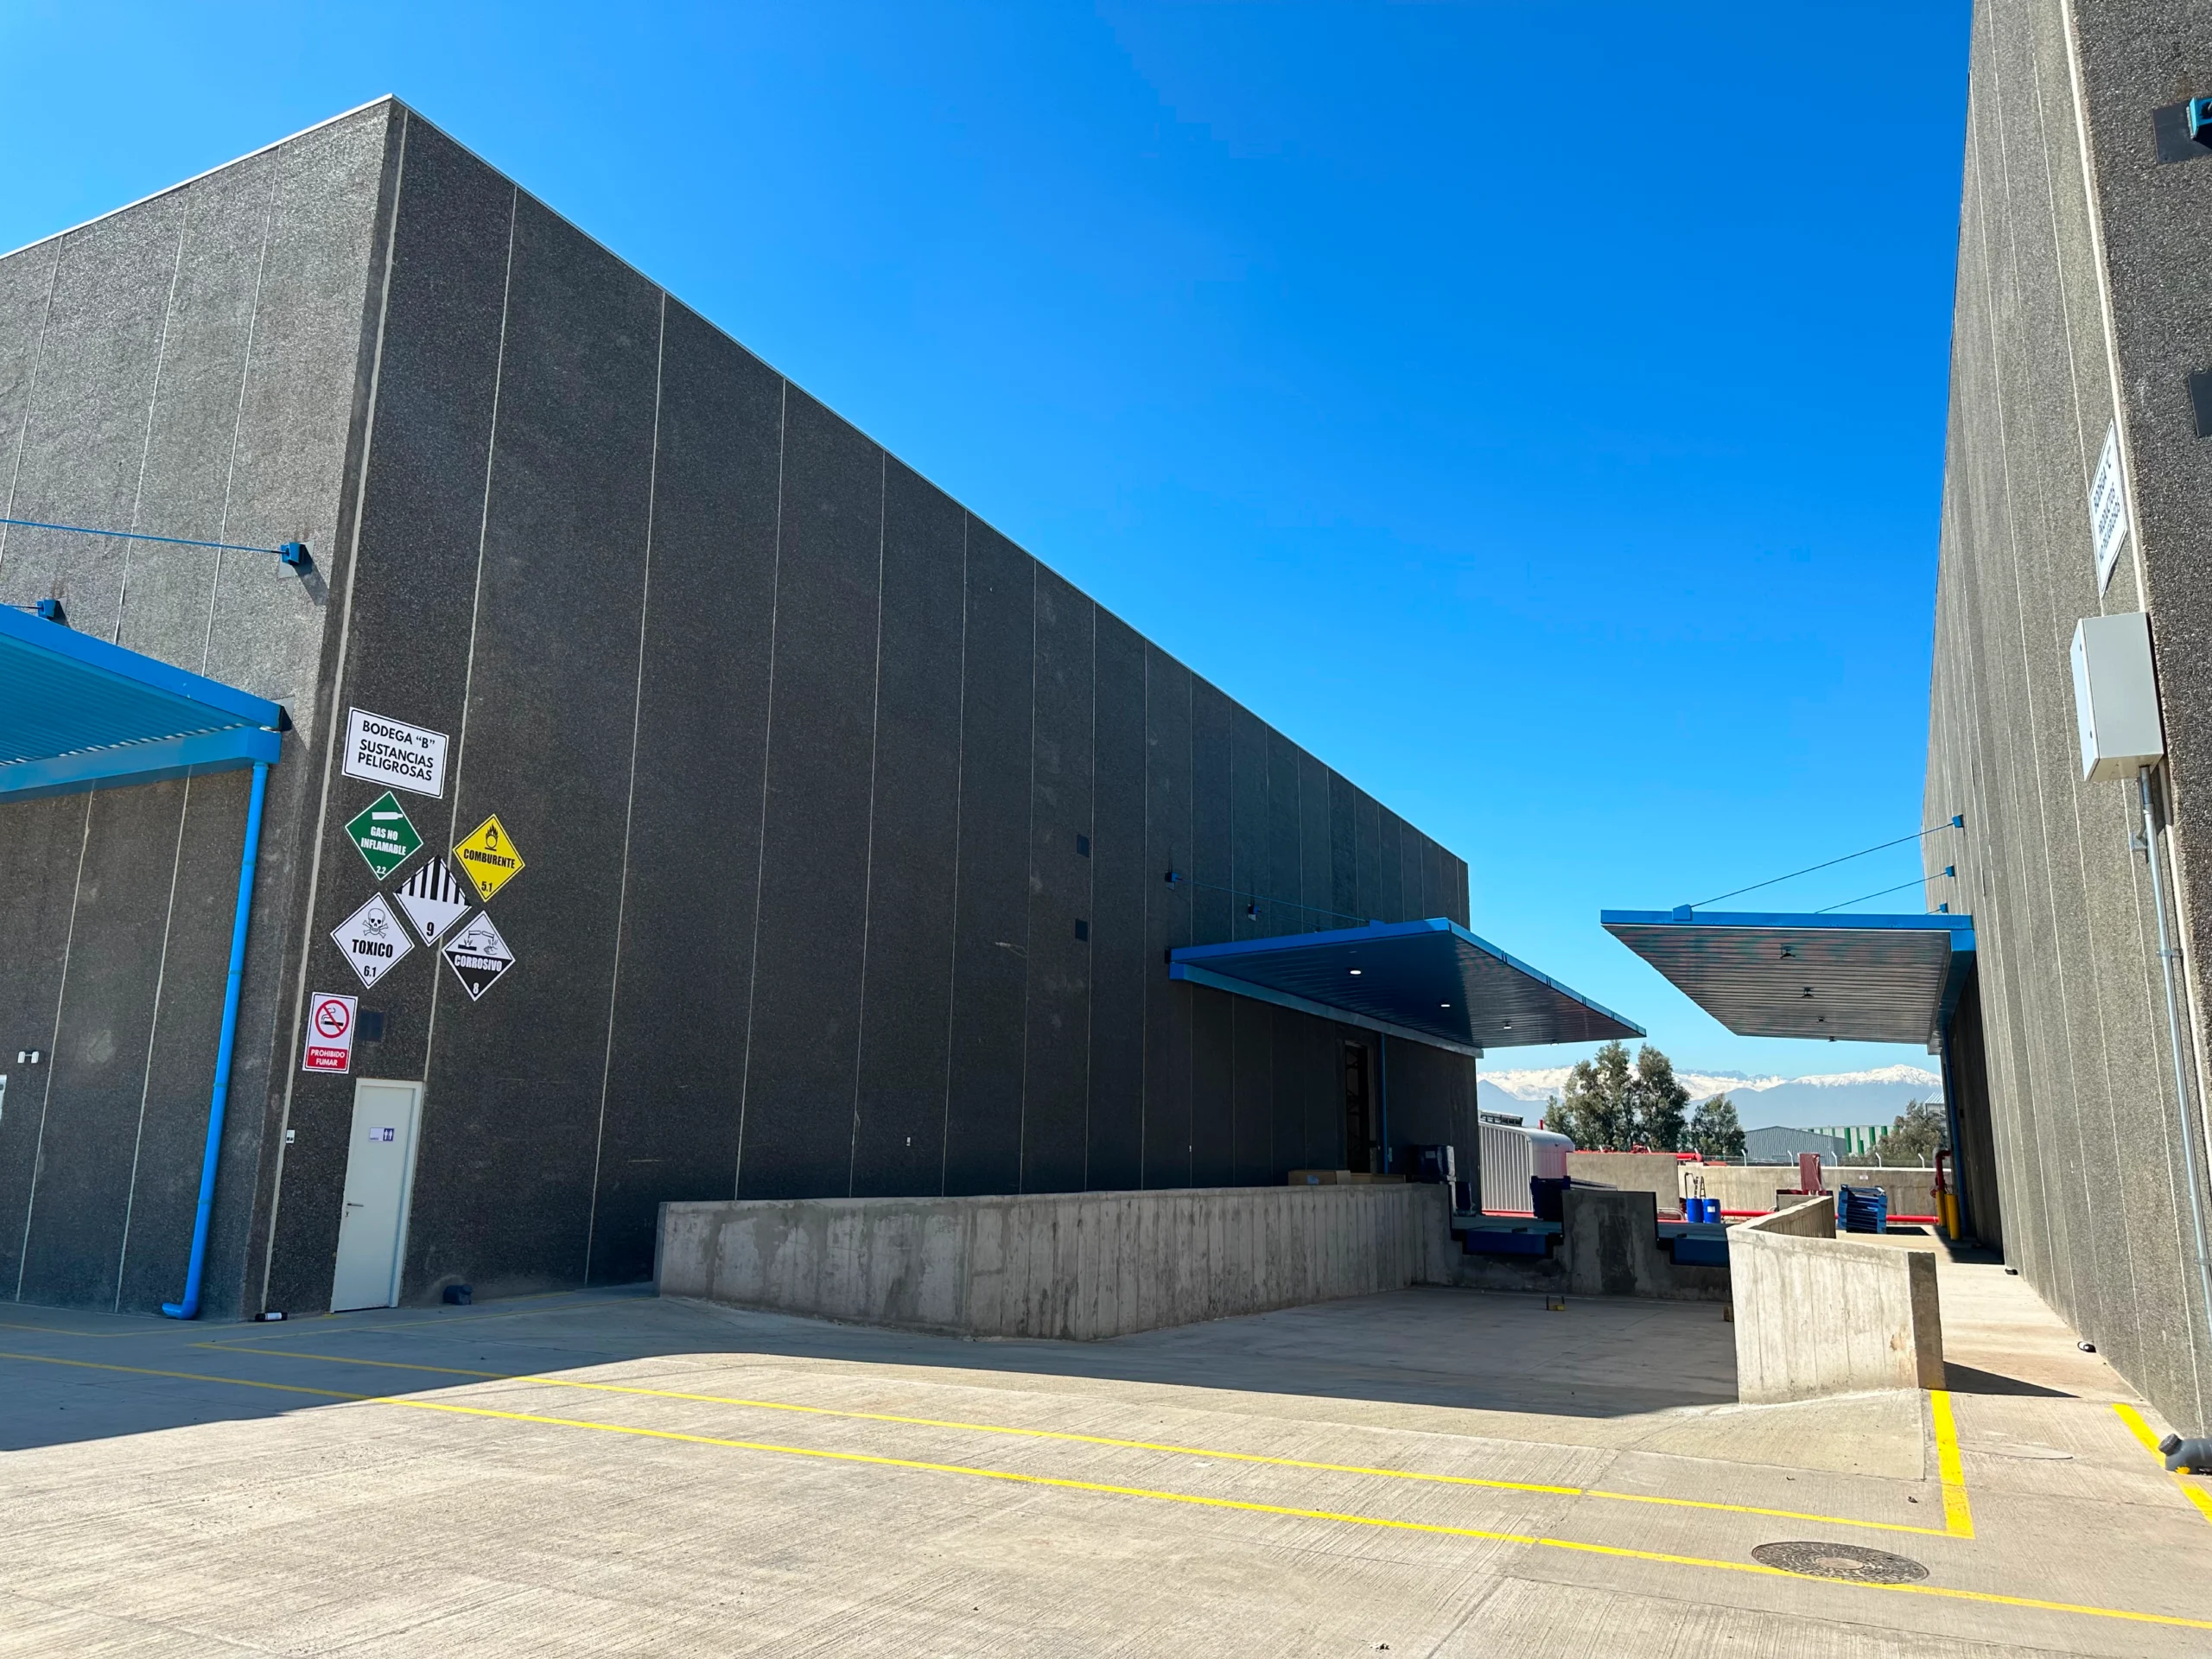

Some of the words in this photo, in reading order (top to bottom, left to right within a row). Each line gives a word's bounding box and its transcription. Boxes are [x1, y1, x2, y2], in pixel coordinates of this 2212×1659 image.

[362, 720, 413, 745] BODEGA
[359, 739, 434, 768] SUSTANCIAS
[358, 752, 432, 781] PELIGROSAS
[371, 826, 386, 840] GAS
[387, 830, 398, 841] NO
[360, 837, 407, 856] INFLAMABLE
[463, 849, 516, 869] COMBURENTE
[376, 866, 386, 874] 2.2
[480, 880, 493, 893] 5.1
[426, 921, 435, 937] 9
[352, 938, 393, 958] TOXICO
[454, 954, 503, 972] CORROSIVO
[363, 965, 377, 978] 6.1
[473, 982, 480, 995] 8
[310, 1049, 346, 1058] PROHIBIDO
[315, 1058, 338, 1066] FUMAR
